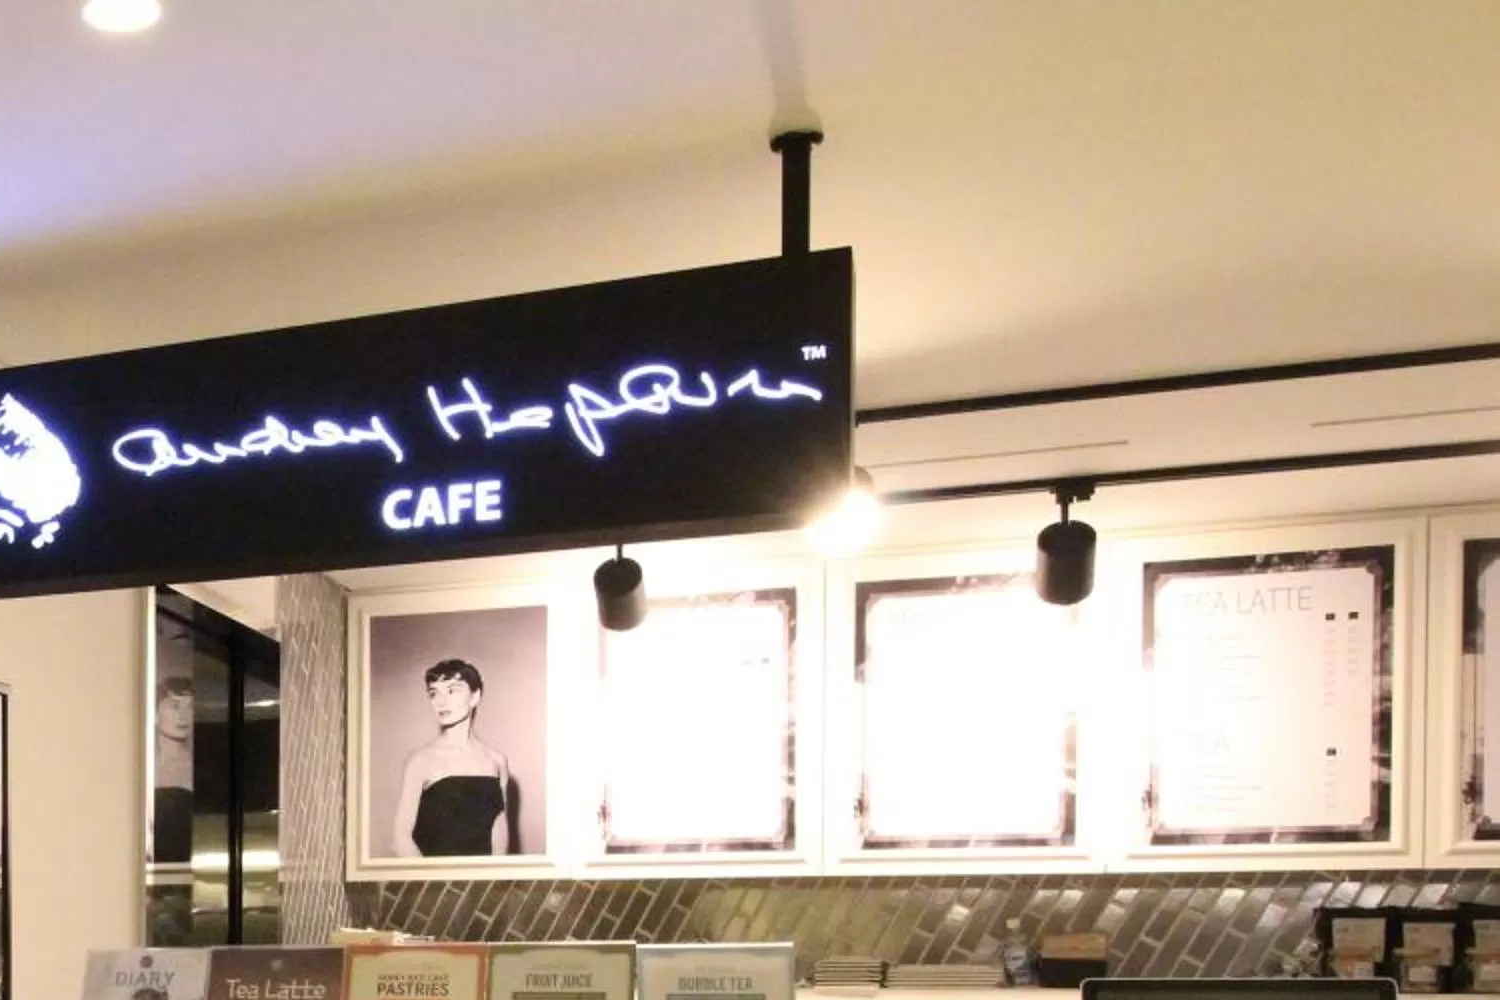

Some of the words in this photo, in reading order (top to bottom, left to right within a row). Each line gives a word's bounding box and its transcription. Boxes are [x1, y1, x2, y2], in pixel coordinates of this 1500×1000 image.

[382, 480, 502, 530] CAFE
[1236, 585, 1313, 614] LATTE
[115, 971, 176, 988] DIARY
[226, 979, 259, 999] Tea
[265, 980, 326, 1000] Latte
[377, 982, 450, 997] PASTRIES
